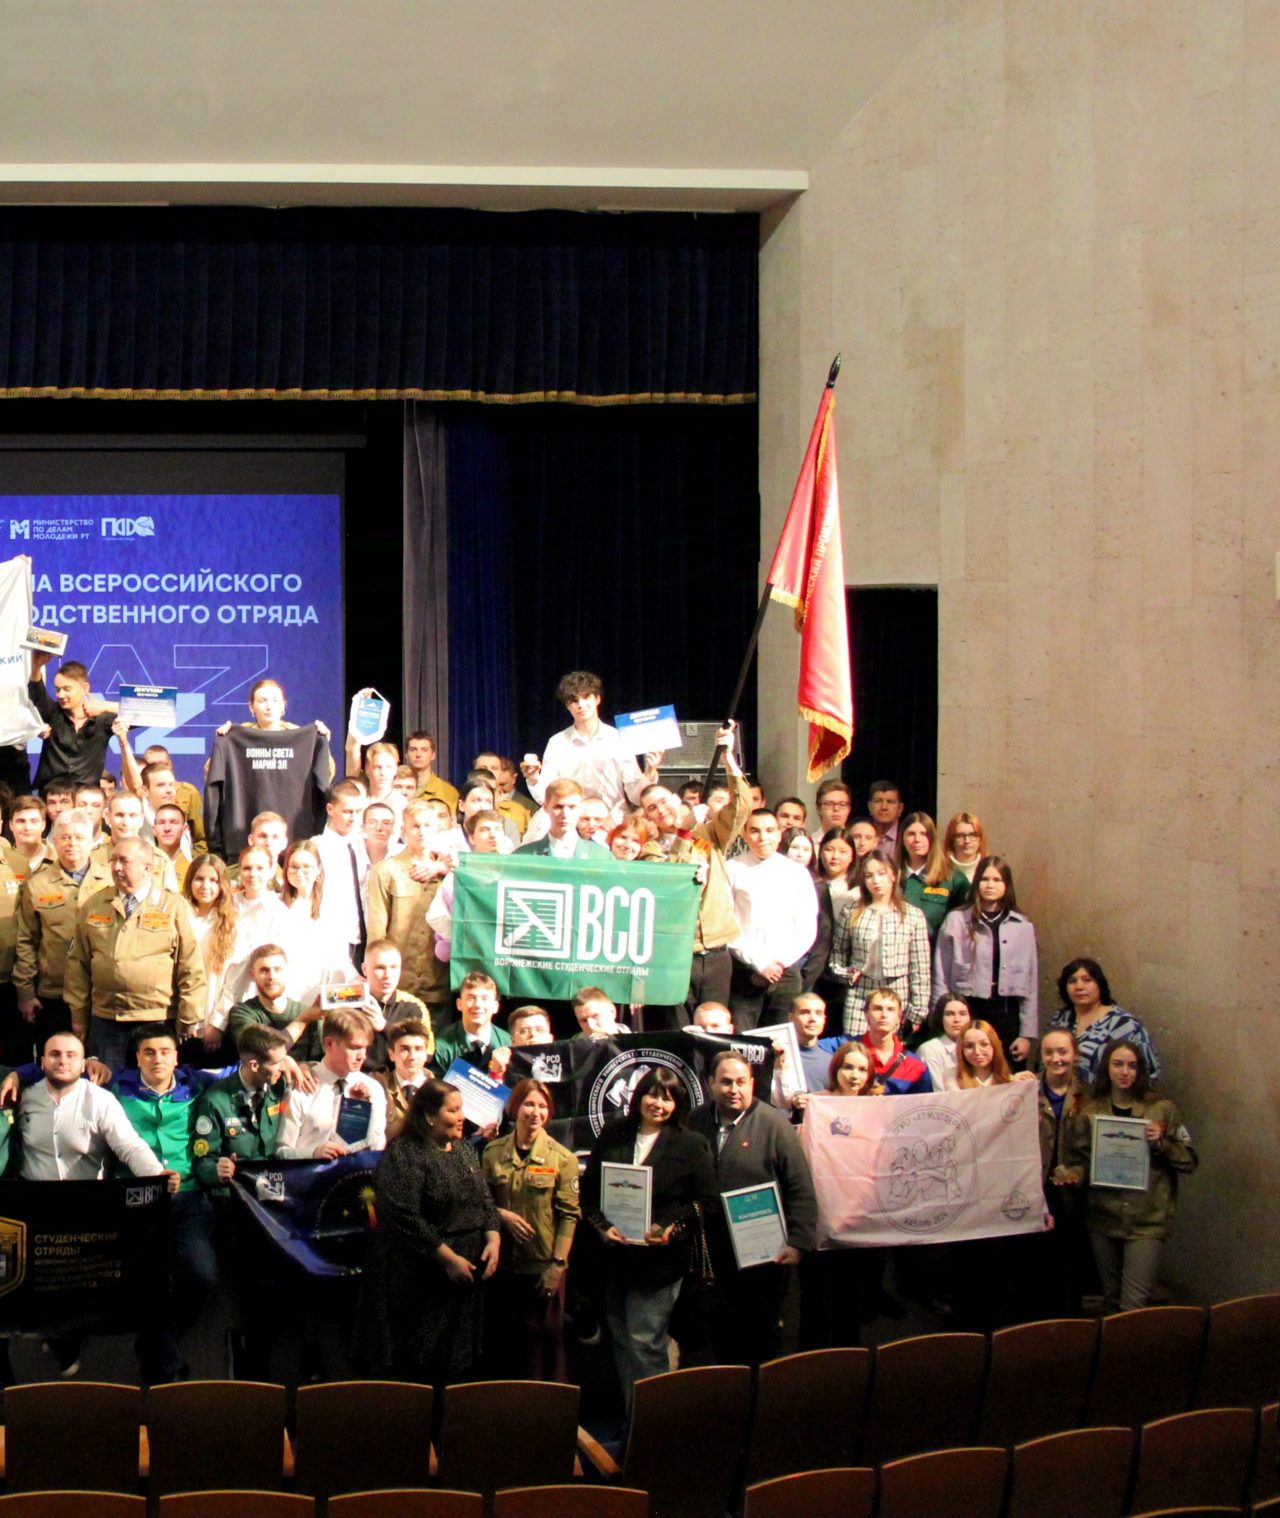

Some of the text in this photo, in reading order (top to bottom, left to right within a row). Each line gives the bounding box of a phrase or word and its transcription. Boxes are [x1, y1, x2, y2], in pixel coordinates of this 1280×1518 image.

[59, 568, 302, 593] ВСЕРОССИЙСКОГО
[217, 604, 319, 627] ОТРЯДА
[246, 747, 294, 759] ВОИНЫ СВЕТА
[252, 758, 288, 770] МАРИЙ ЭЛ
[577, 884, 655, 965] ВСО
[494, 957, 649, 976] ВОРОНЕЖСКИЕ СТУДЕНЧЕСКИЕ ОТРЯДЫ
[546, 1054, 561, 1064] РСО
[747, 1044, 765, 1062] ВСО
[269, 1172, 283, 1182] РСО
[34, 1246, 81, 1256] ОТРЯДЫ
